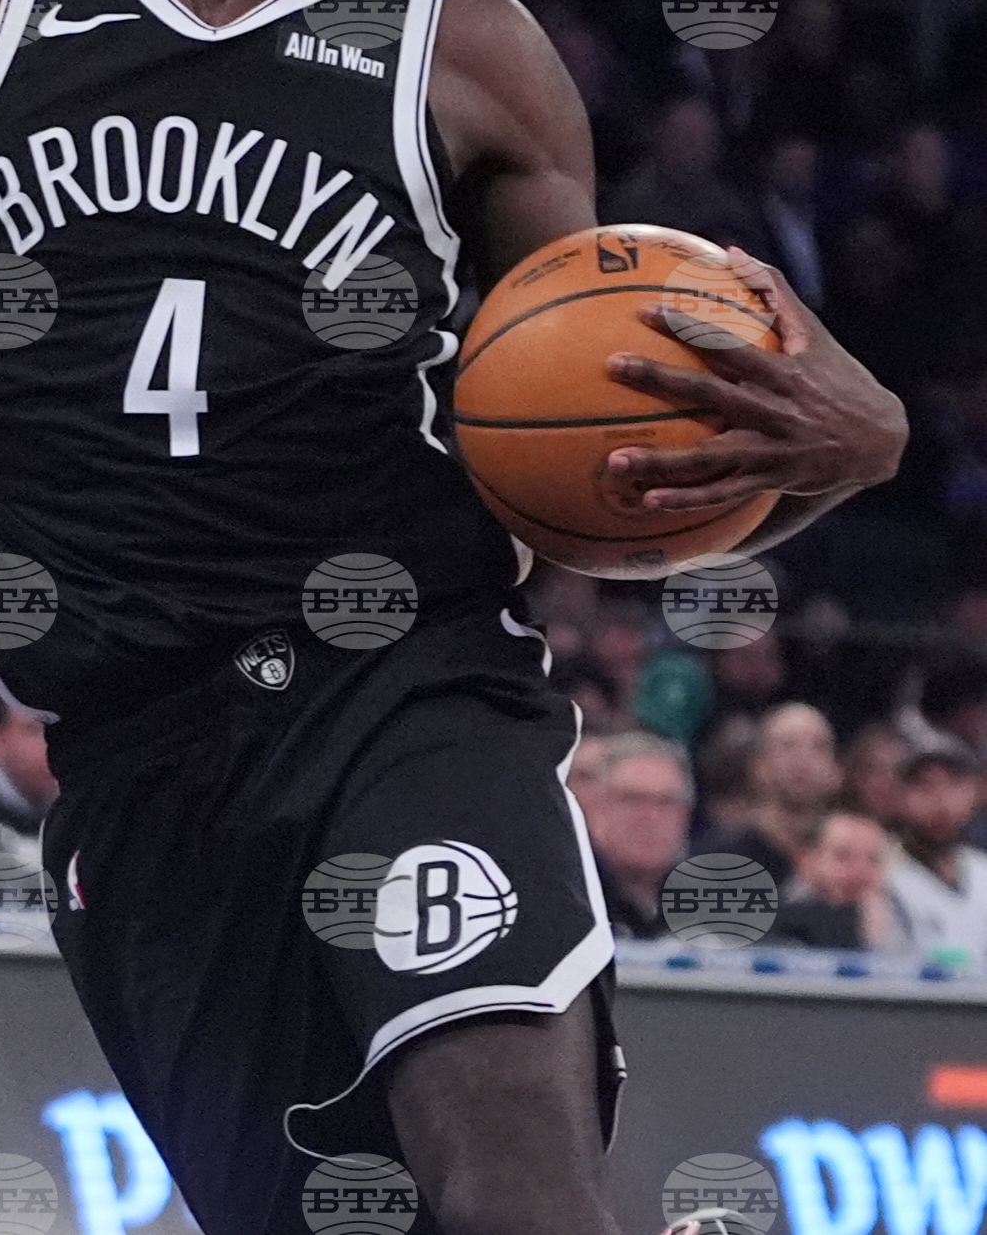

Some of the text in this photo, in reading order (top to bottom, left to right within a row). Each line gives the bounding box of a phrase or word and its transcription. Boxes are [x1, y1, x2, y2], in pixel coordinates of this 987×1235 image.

[284, 32, 385, 79] All In Won
[123, 277, 208, 457] 4
[240, 633, 288, 672] NETS
[416, 860, 462, 956] B
